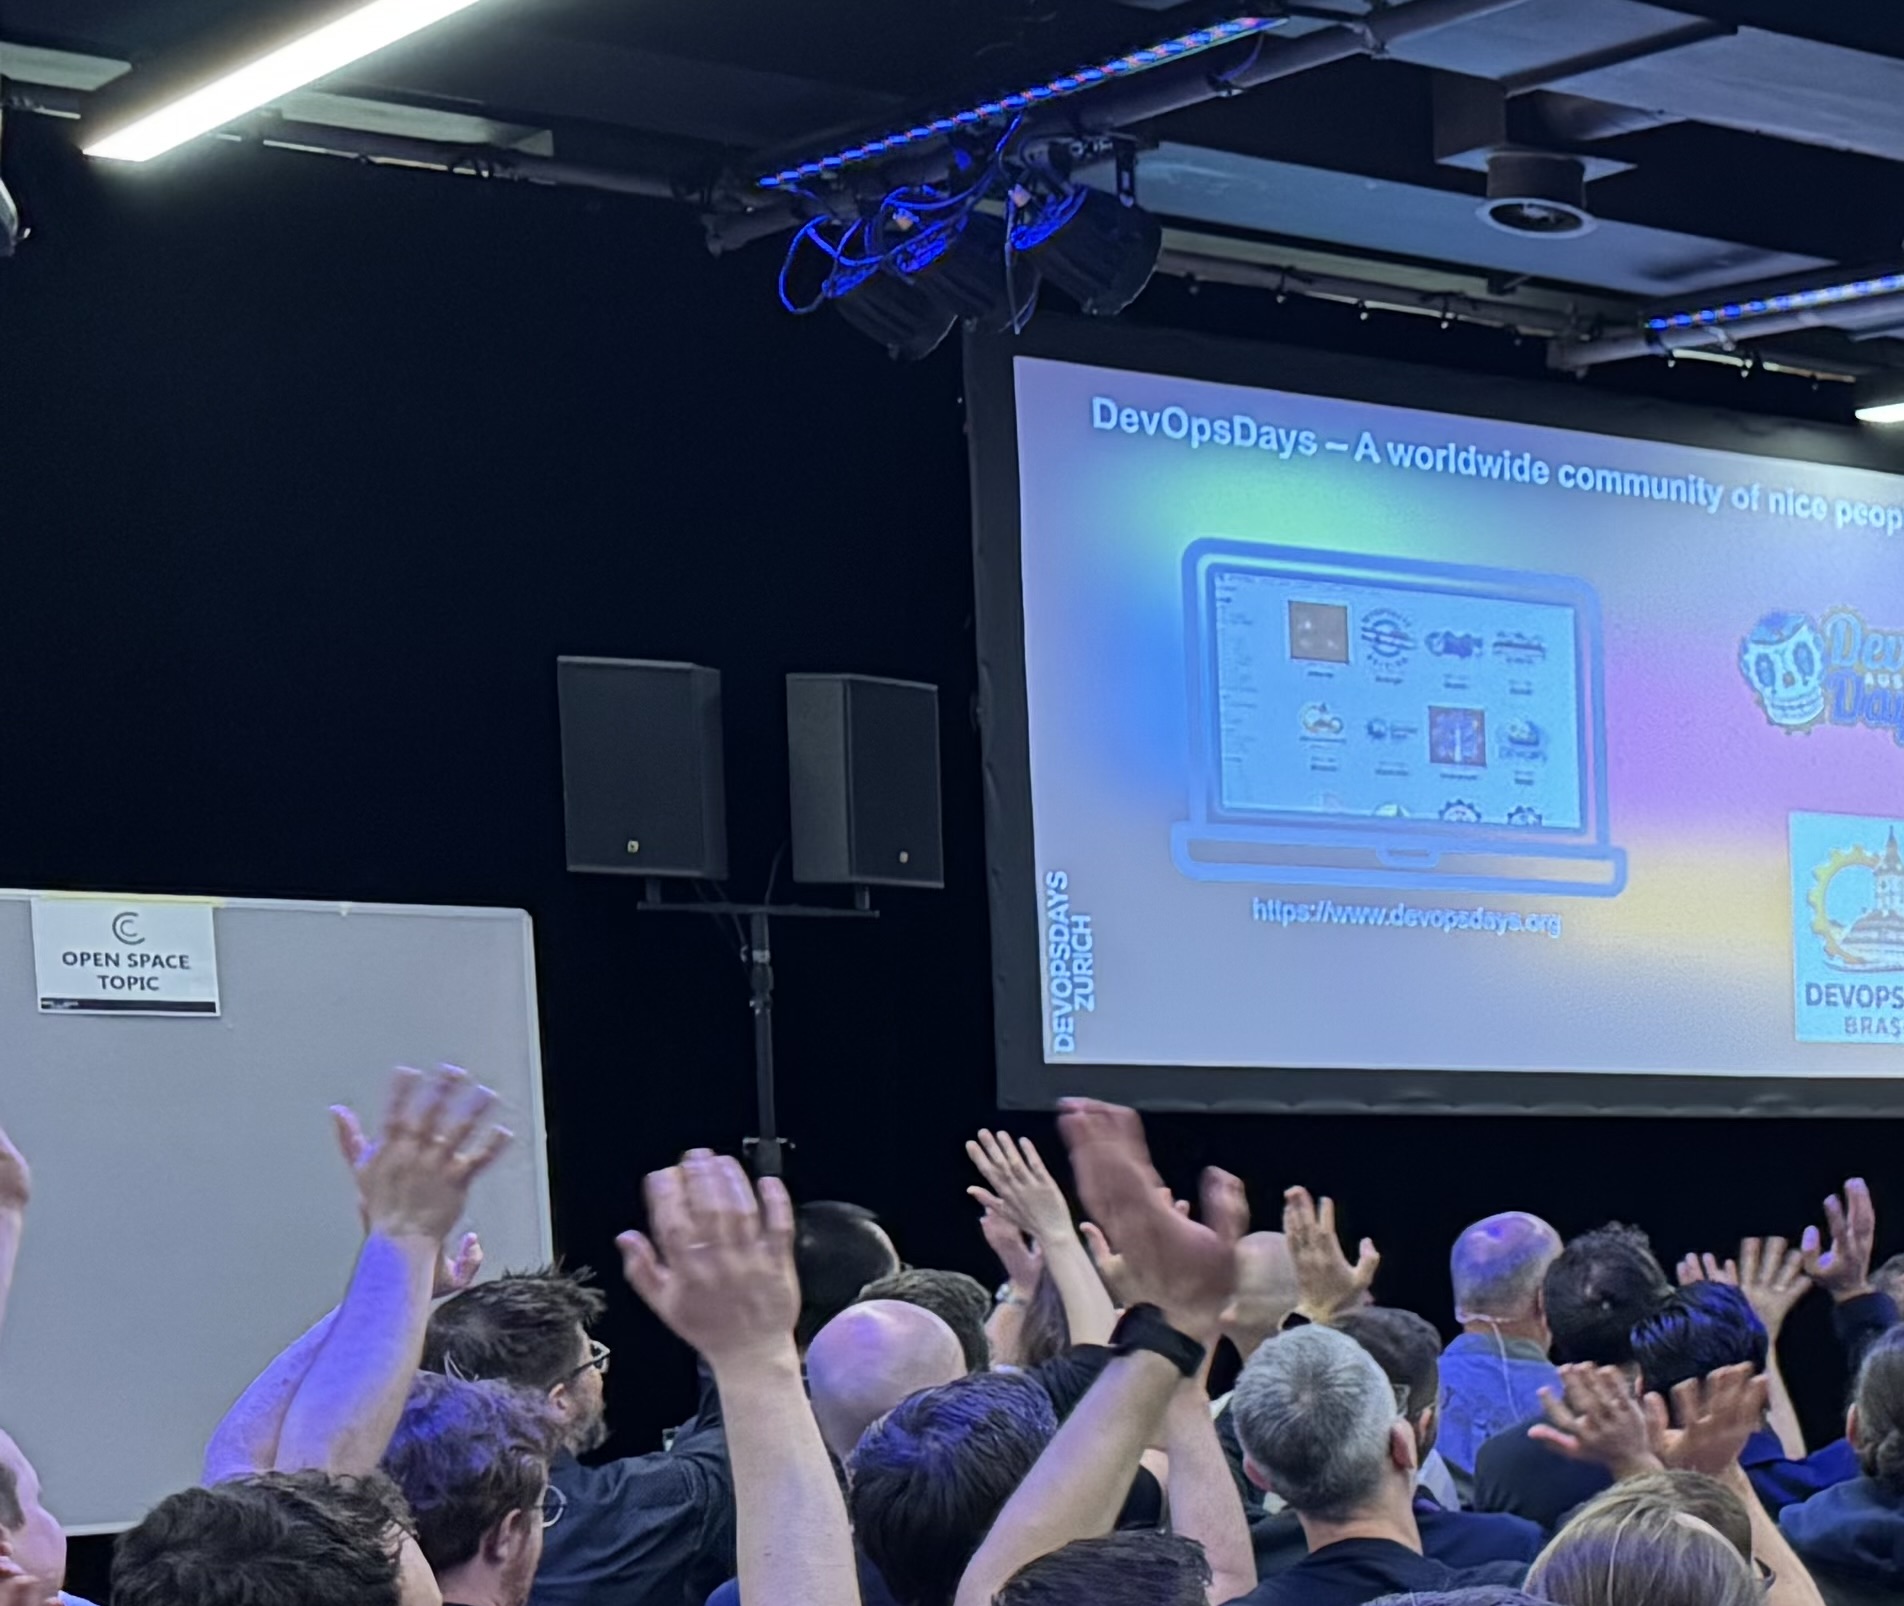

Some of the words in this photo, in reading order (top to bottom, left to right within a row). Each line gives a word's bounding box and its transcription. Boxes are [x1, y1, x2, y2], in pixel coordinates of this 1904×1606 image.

[1091, 397, 1318, 460] DevOpsDays
[1354, 431, 1381, 464] A
[1387, 441, 1550, 485] worldwide
[1558, 464, 1724, 514] community
[1731, 482, 1760, 512] of
[1769, 486, 1828, 521] nice
[1252, 897, 1562, 939] https://www.devopsdays.org
[62, 951, 120, 969] OPEN
[128, 953, 192, 970] SPACE
[97, 974, 160, 991] TOPIC
[1045, 870, 1076, 1054] DEVOPSDAYS
[1070, 914, 1096, 1013] ZURICH
